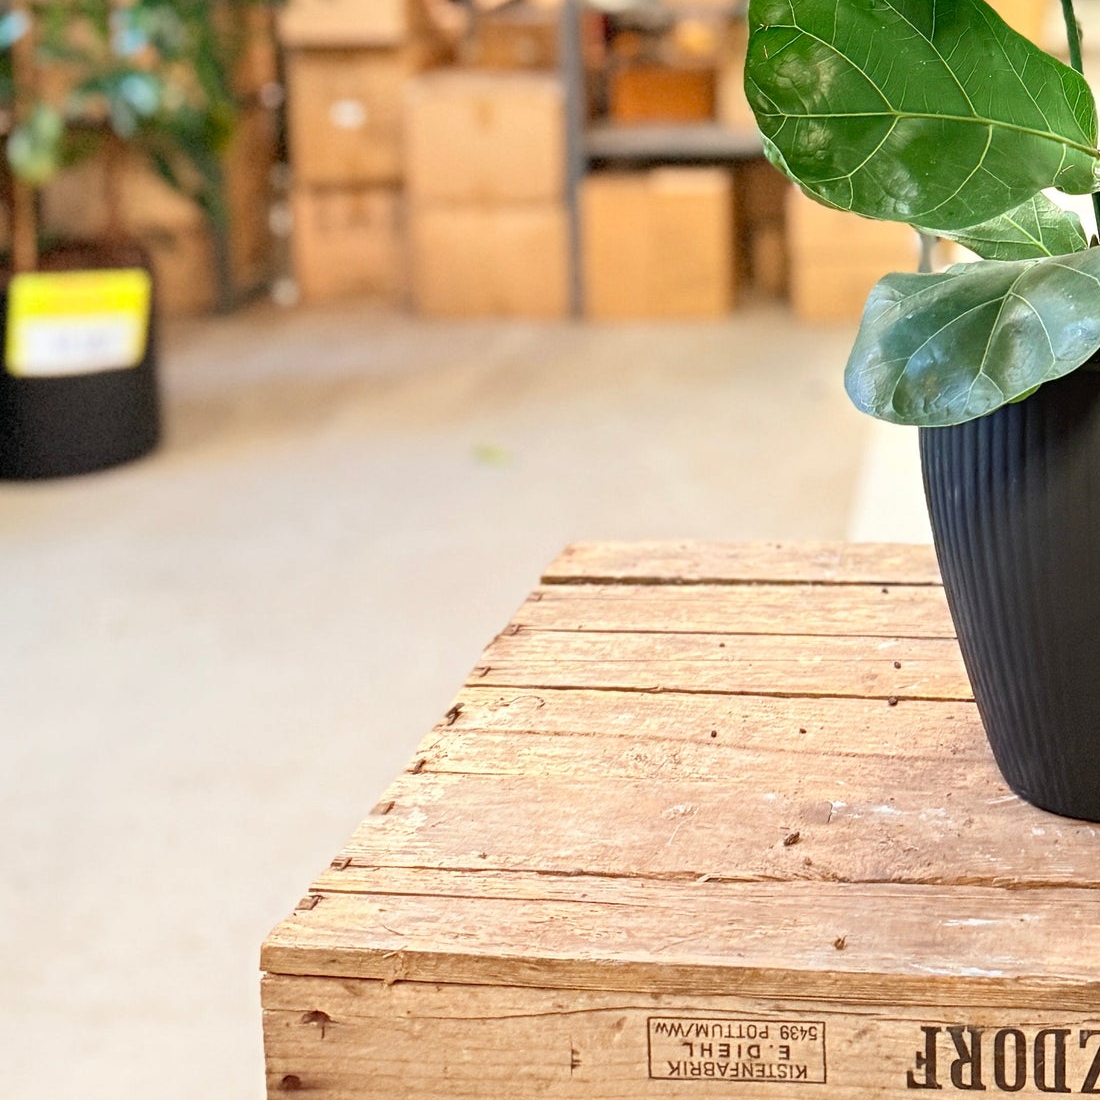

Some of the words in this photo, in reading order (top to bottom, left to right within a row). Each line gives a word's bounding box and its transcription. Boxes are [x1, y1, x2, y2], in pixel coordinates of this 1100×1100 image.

[779, 1025, 818, 1041] 5439
[682, 1042, 761, 1059] DIEHL
[769, 1044, 791, 1061] E.
[667, 1060, 808, 1079] KISTENFABRIK
